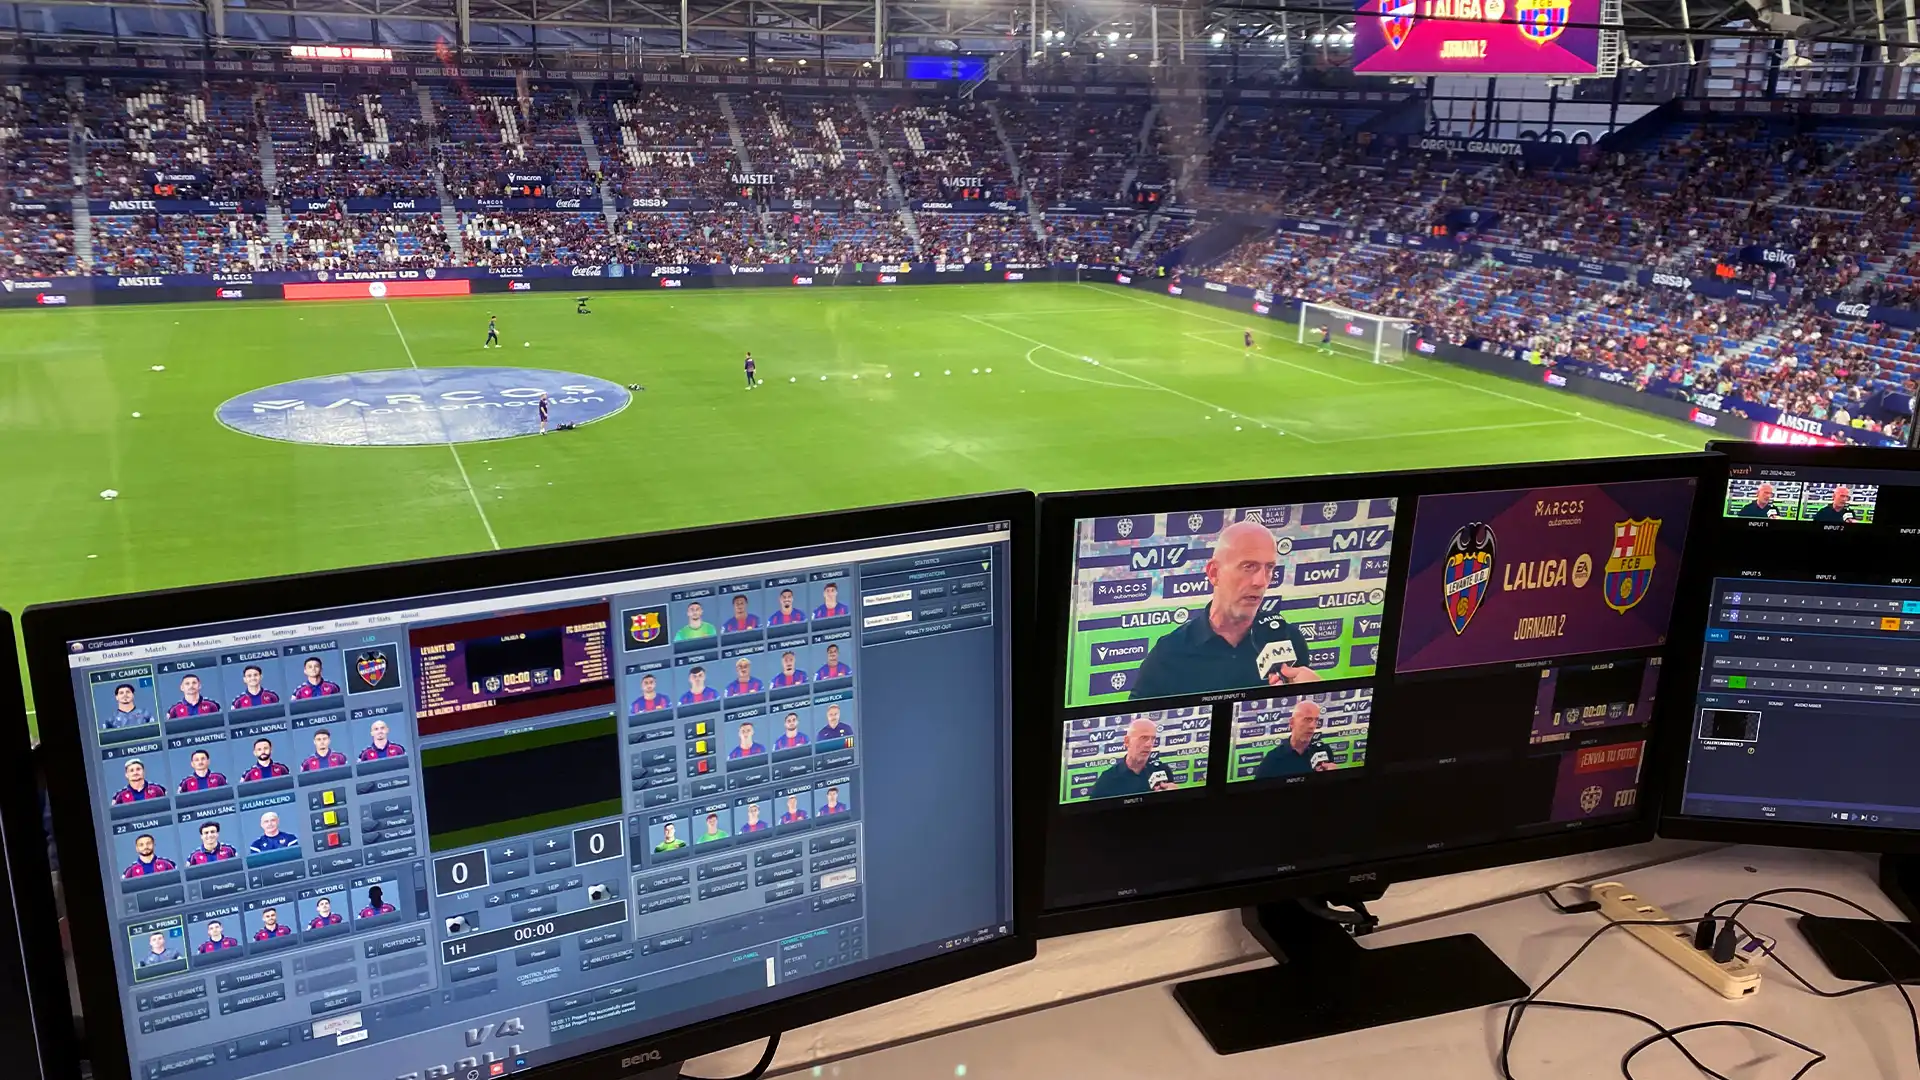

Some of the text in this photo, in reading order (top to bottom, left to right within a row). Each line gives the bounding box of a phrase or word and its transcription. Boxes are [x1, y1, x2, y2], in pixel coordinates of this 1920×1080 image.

[1478, 40, 1488, 58] 2
[1421, 139, 1523, 156] ORGULL GRANOTA
[732, 174, 776, 185] AMSTEL
[109, 201, 156, 210] AMSTEL
[1763, 249, 1796, 269] teiko
[335, 271, 419, 280] LEVANTE UD
[118, 277, 163, 287] AMSTEL
[1777, 414, 1824, 436] AMSTEL
[1536, 500, 1584, 517] MARCOS
[1620, 558, 1640, 569] FCB
[1504, 559, 1567, 591] LALIGA
[1099, 583, 1147, 595] MARCOS
[1448, 578, 1473, 594] LEVANTE
[1319, 593, 1366, 608] LALIGA
[1122, 611, 1171, 628] LALIGA
[308, 624, 325, 632] Timer
[1514, 614, 1567, 641] JORNADA 2
[88, 638, 128, 650] CGFootball
[192, 638, 222, 647] Modules
[102, 650, 134, 660] Database
[145, 645, 167, 654] Match
[421, 645, 446, 656] LEVANTE
[1109, 646, 1144, 656] macron
[239, 650, 278, 662] ELGEZABAL
[177, 662, 195, 670] DELA
[118, 668, 149, 678] CAMPOS
[472, 669, 561, 695] 0 00:00 0
[309, 715, 337, 725] CABELLO
[128, 743, 158, 754] ROMERO
[1607, 751, 1616, 762] TU
[265, 795, 291, 805] CALERO
[196, 809, 217, 818] MANU
[132, 820, 159, 830] TOLJAN
[589, 833, 605, 855] 0
[452, 862, 469, 884] 0
[367, 876, 382, 884] IKER
[212, 882, 235, 892] Penalty
[449, 922, 555, 956] 1H 00:00
[621, 1050, 662, 1069] BenQ
